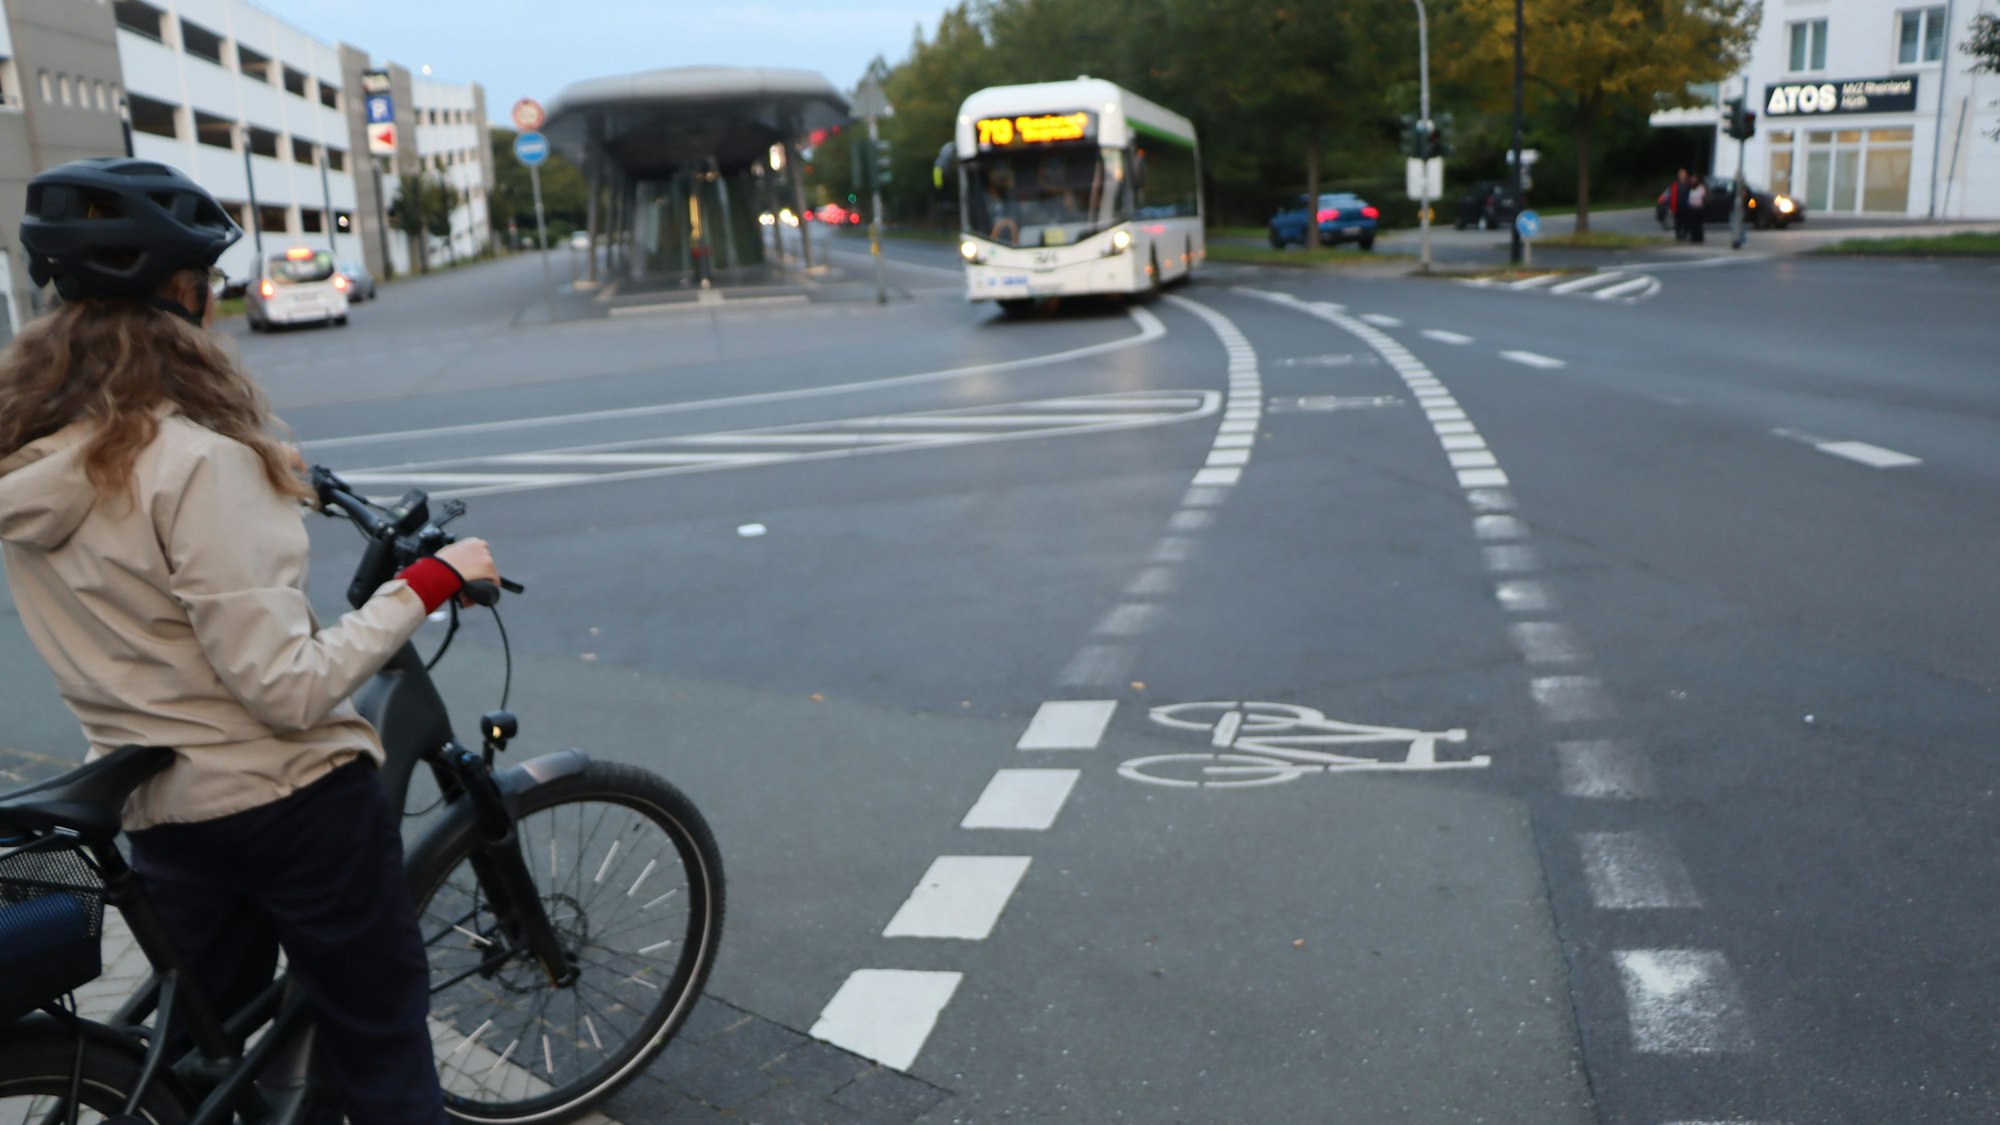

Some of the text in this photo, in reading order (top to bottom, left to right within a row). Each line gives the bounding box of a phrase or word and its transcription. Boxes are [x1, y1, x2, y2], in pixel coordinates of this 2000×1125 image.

[1767, 83, 1838, 114] ATOS
[1842, 79, 1911, 96] MVZ Rheinland
